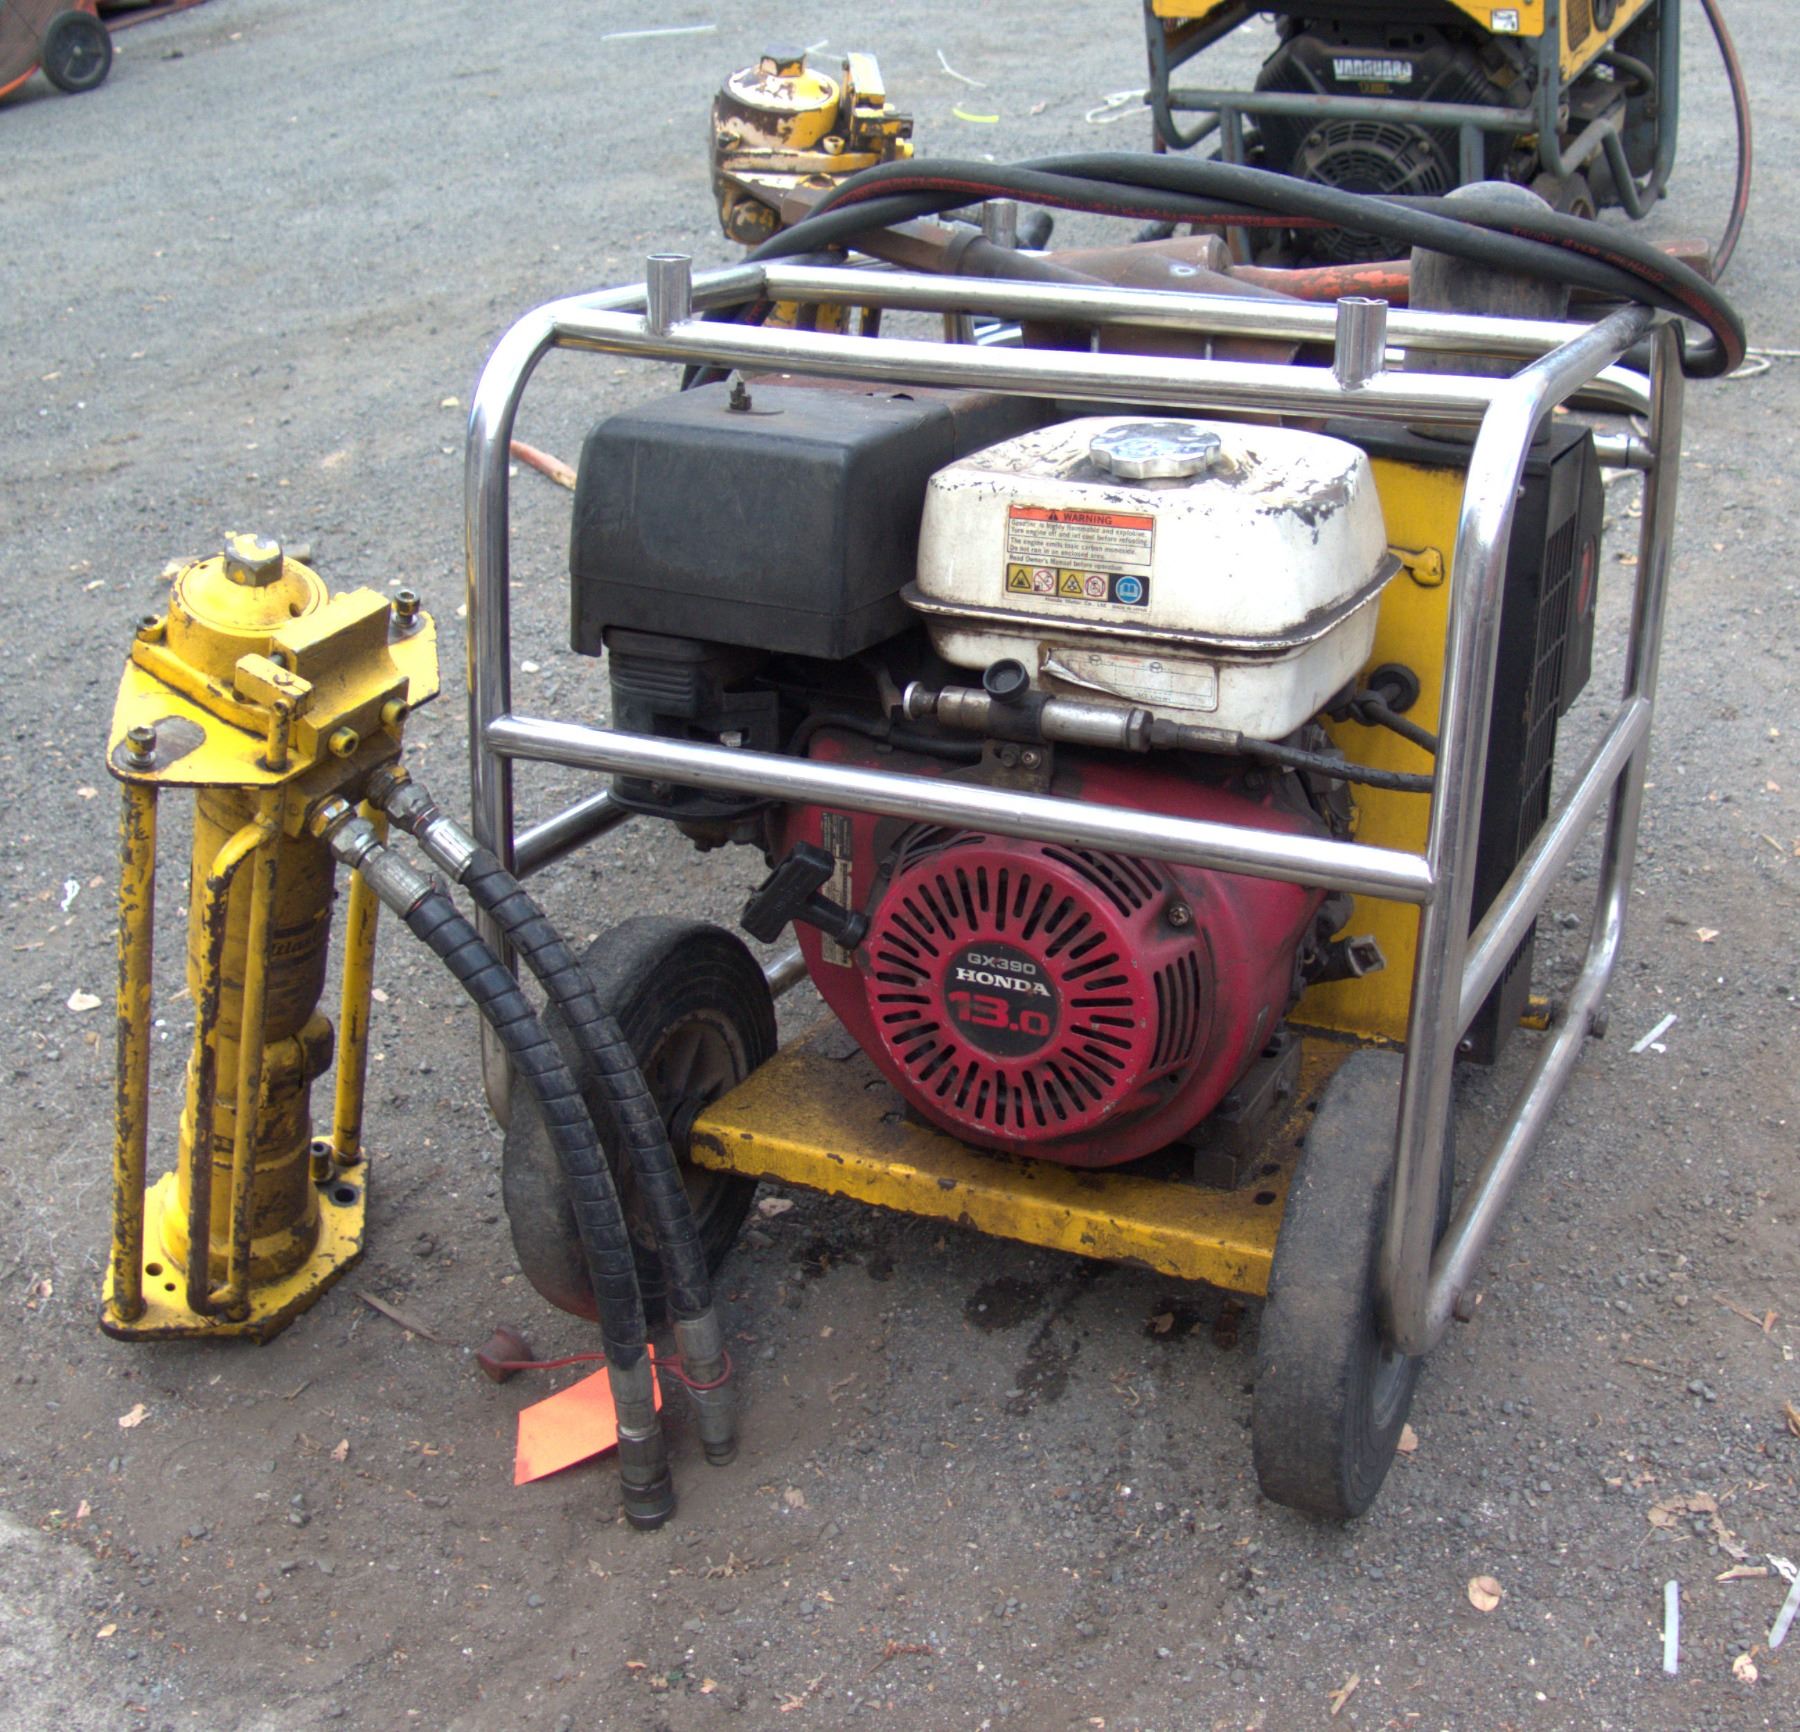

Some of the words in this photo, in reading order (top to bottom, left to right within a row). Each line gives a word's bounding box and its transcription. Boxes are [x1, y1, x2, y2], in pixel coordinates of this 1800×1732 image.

[1333, 59, 1412, 77] VANGUARD
[1063, 511, 1112, 525] WARNING
[1025, 529, 1047, 538] engine
[1096, 533, 1117, 542] before
[1102, 526, 1114, 535] and
[1023, 539, 1044, 547] engine
[1081, 544, 1103, 552] carbon
[1060, 549, 1088, 558] enclosed
[1009, 554, 1024, 562] Read
[1025, 555, 1049, 564] Owner's
[1050, 558, 1072, 566] Manual
[1073, 560, 1093, 568] before
[967, 952, 1037, 976] GX390
[955, 967, 1052, 997] HONDA
[948, 990, 1051, 1037] 13.0
